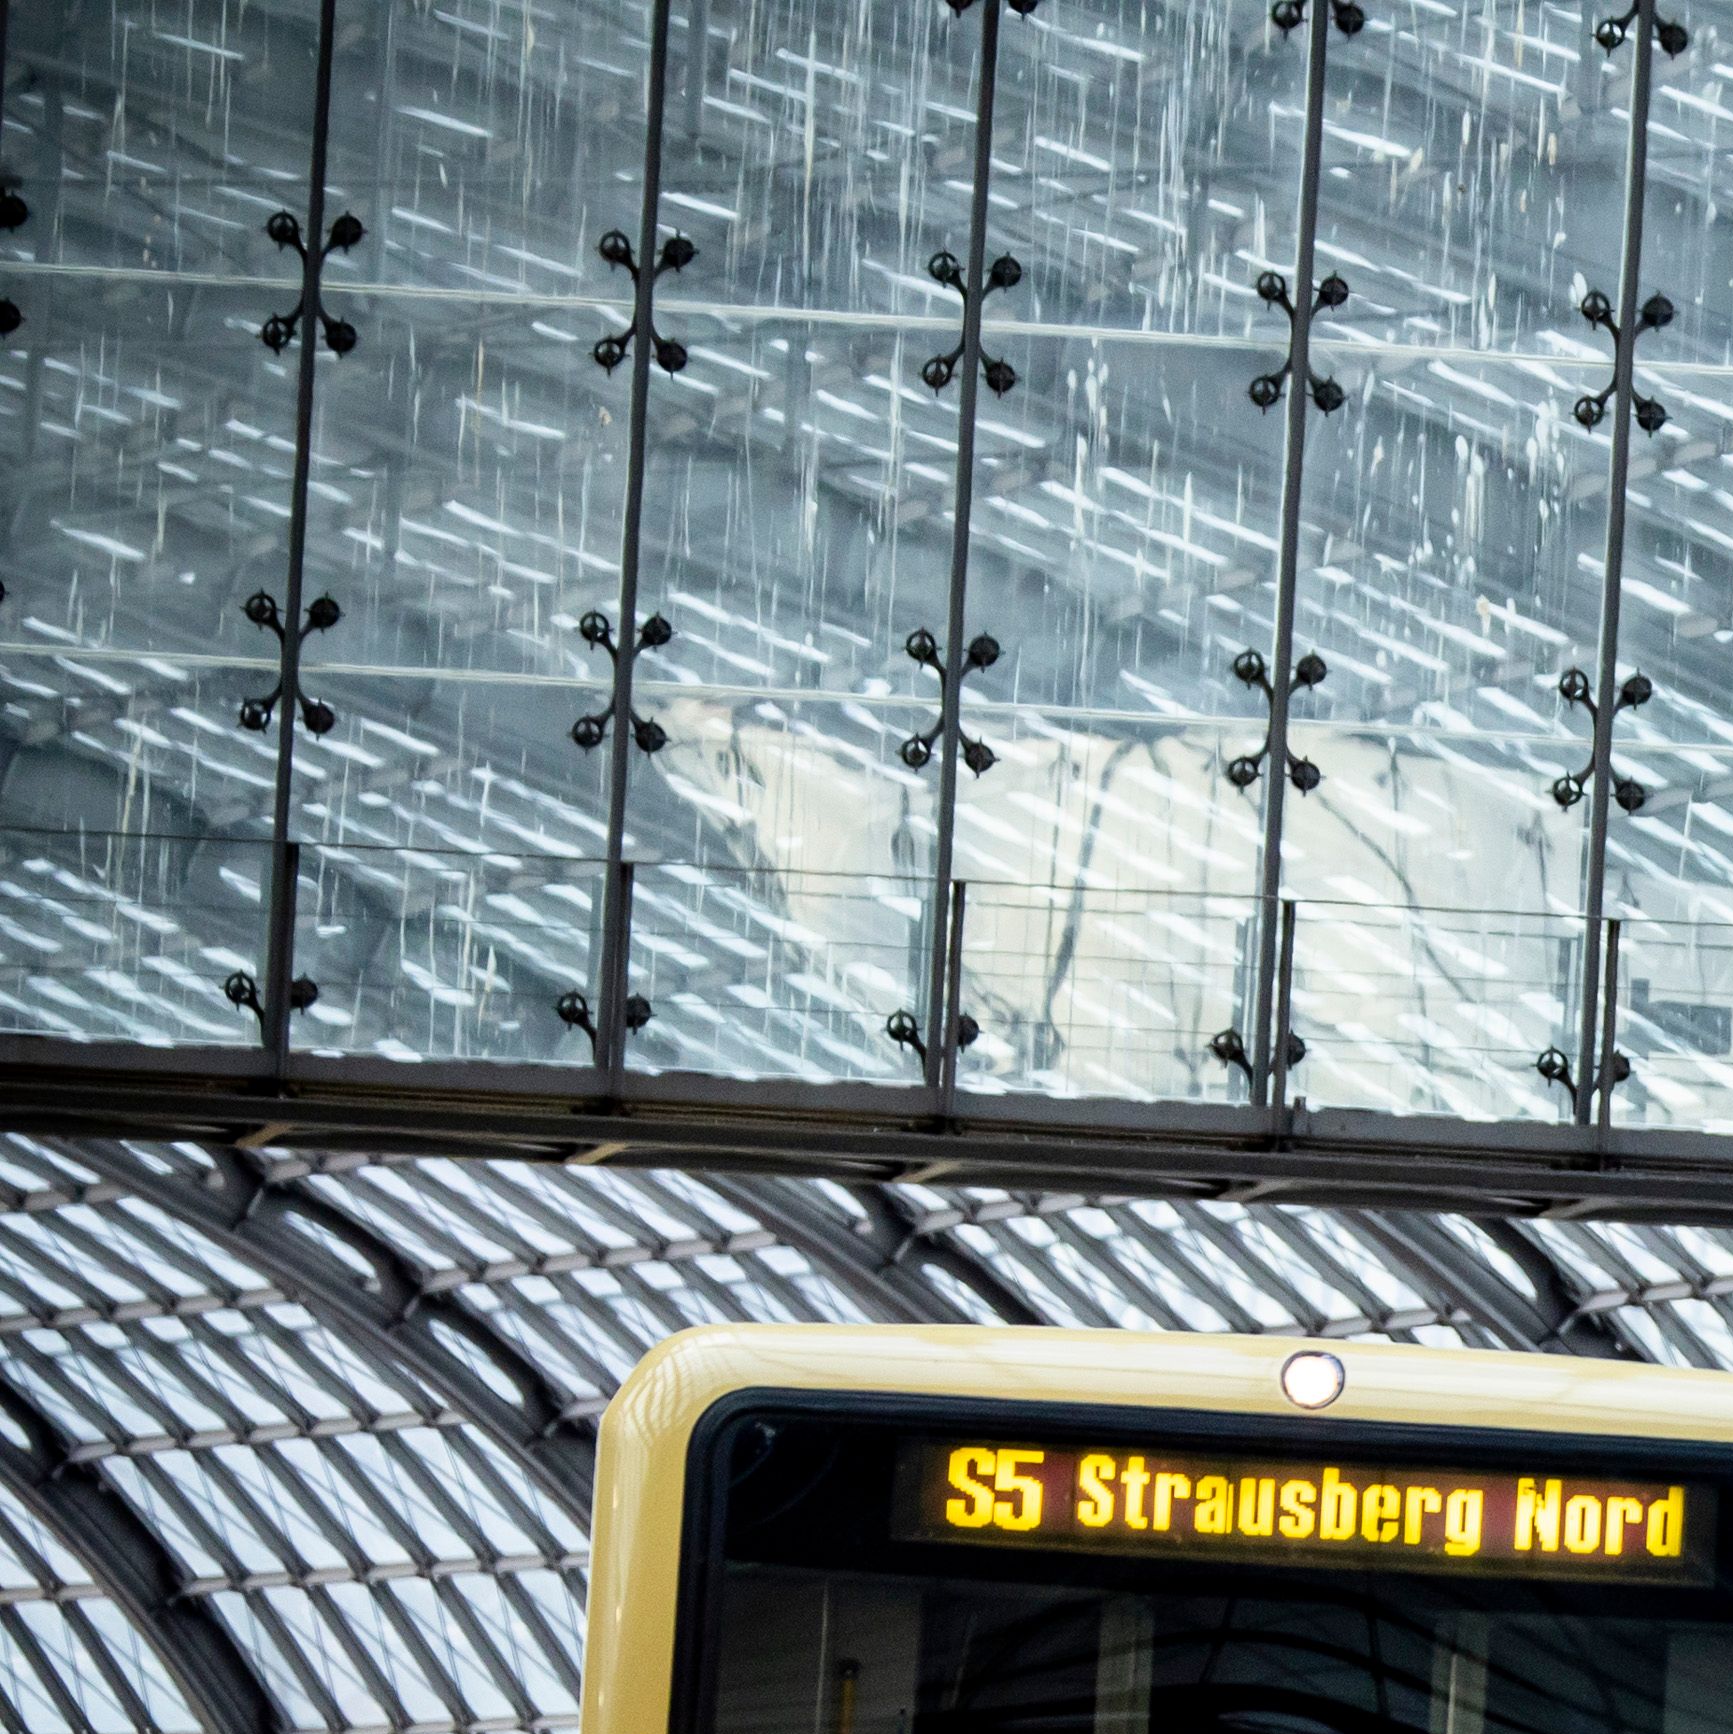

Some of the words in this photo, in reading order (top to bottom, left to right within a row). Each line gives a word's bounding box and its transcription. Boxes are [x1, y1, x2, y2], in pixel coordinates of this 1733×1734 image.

[946, 1446, 1044, 1532] S5
[1075, 1454, 1483, 1557] Strausberg
[1514, 1477, 1686, 1559] Nord
